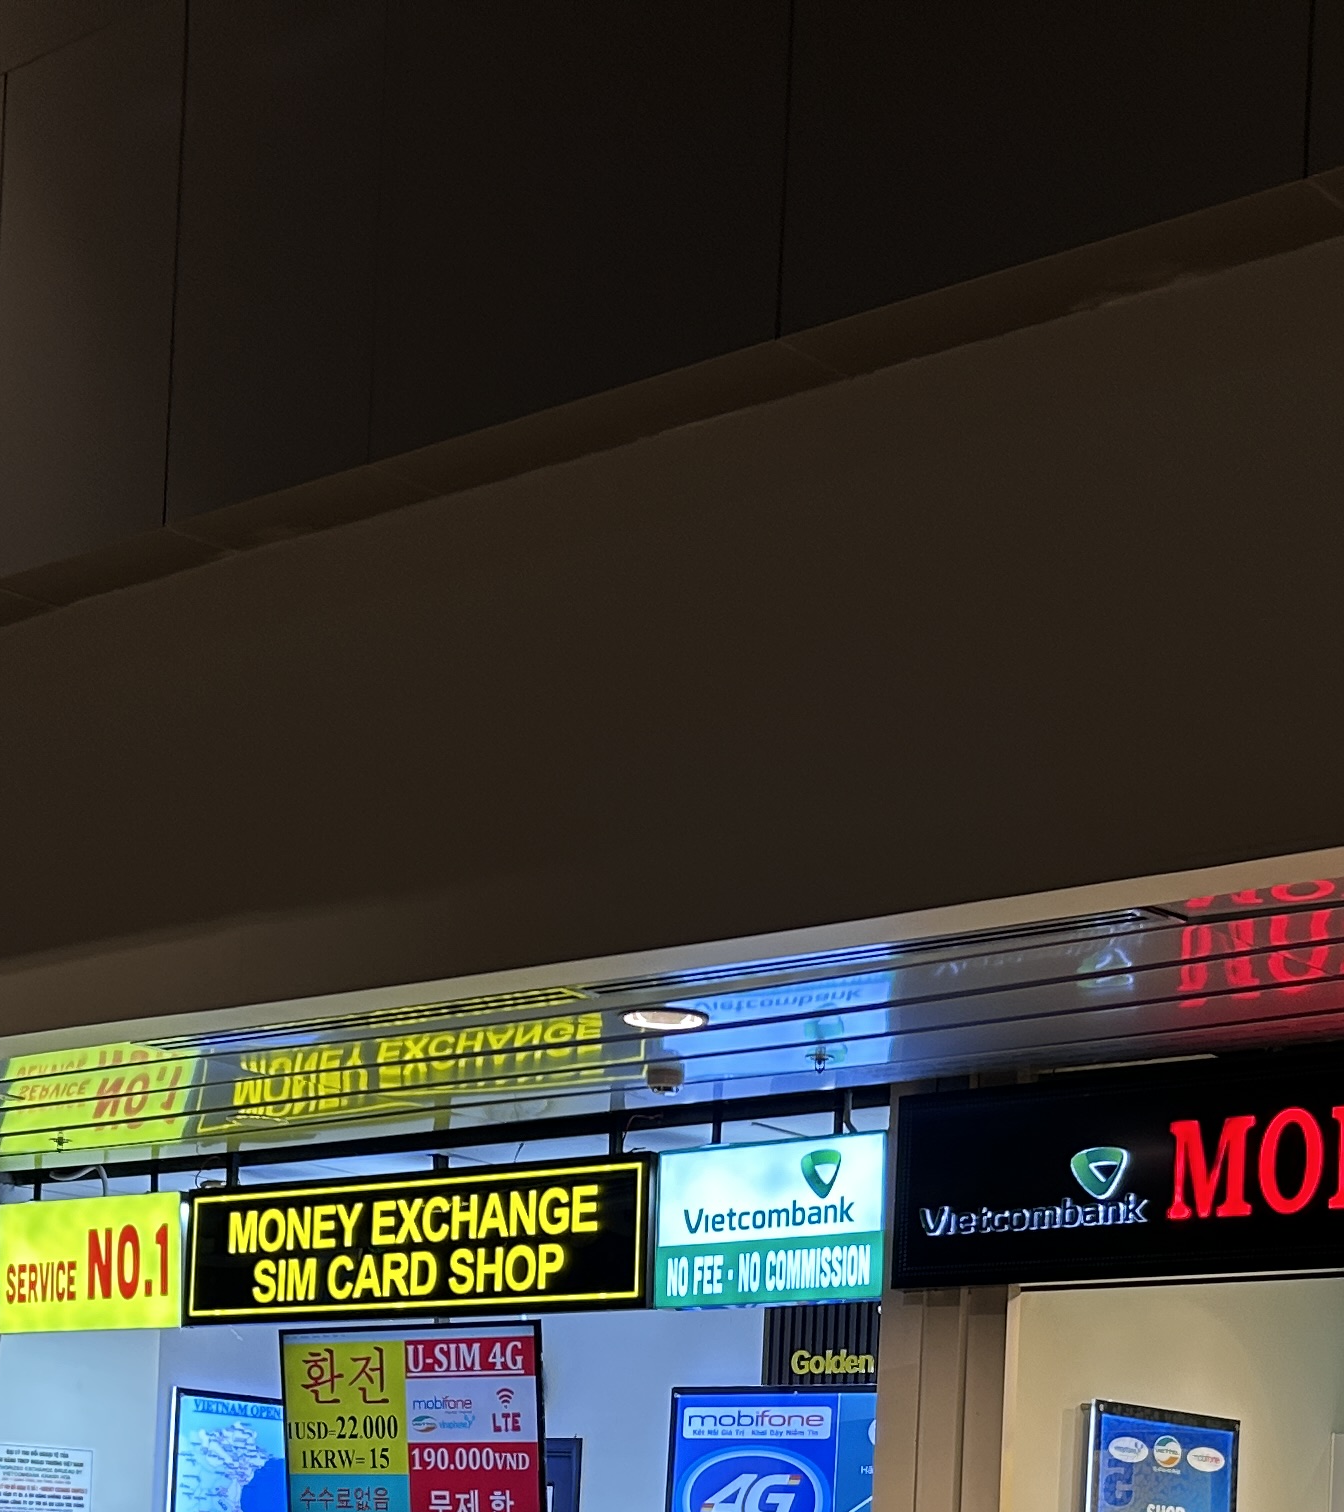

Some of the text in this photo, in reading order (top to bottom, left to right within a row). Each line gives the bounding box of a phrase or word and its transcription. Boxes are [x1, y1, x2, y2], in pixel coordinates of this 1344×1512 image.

[228, 1185, 598, 1254] MONEY EXCHANGE
[683, 1196, 855, 1234] Vietcombank
[919, 1193, 1150, 1237] Vietcombank
[6, 1223, 168, 1304] SERVICE NO.1
[252, 1243, 565, 1303] SIM CARD SHOP
[667, 1244, 871, 1297] NO FEE NO COMMISSION
[301, 1346, 390, 1404] 환전
[407, 1341, 523, 1372] U-SIM 4G
[790, 1349, 874, 1375] Golden
[193, 1399, 282, 1420] VIETNAM OPEN
[492, 1412, 521, 1433] LTE
[688, 1409, 825, 1427] mobifone
[370, 1448, 390, 1469] 15
